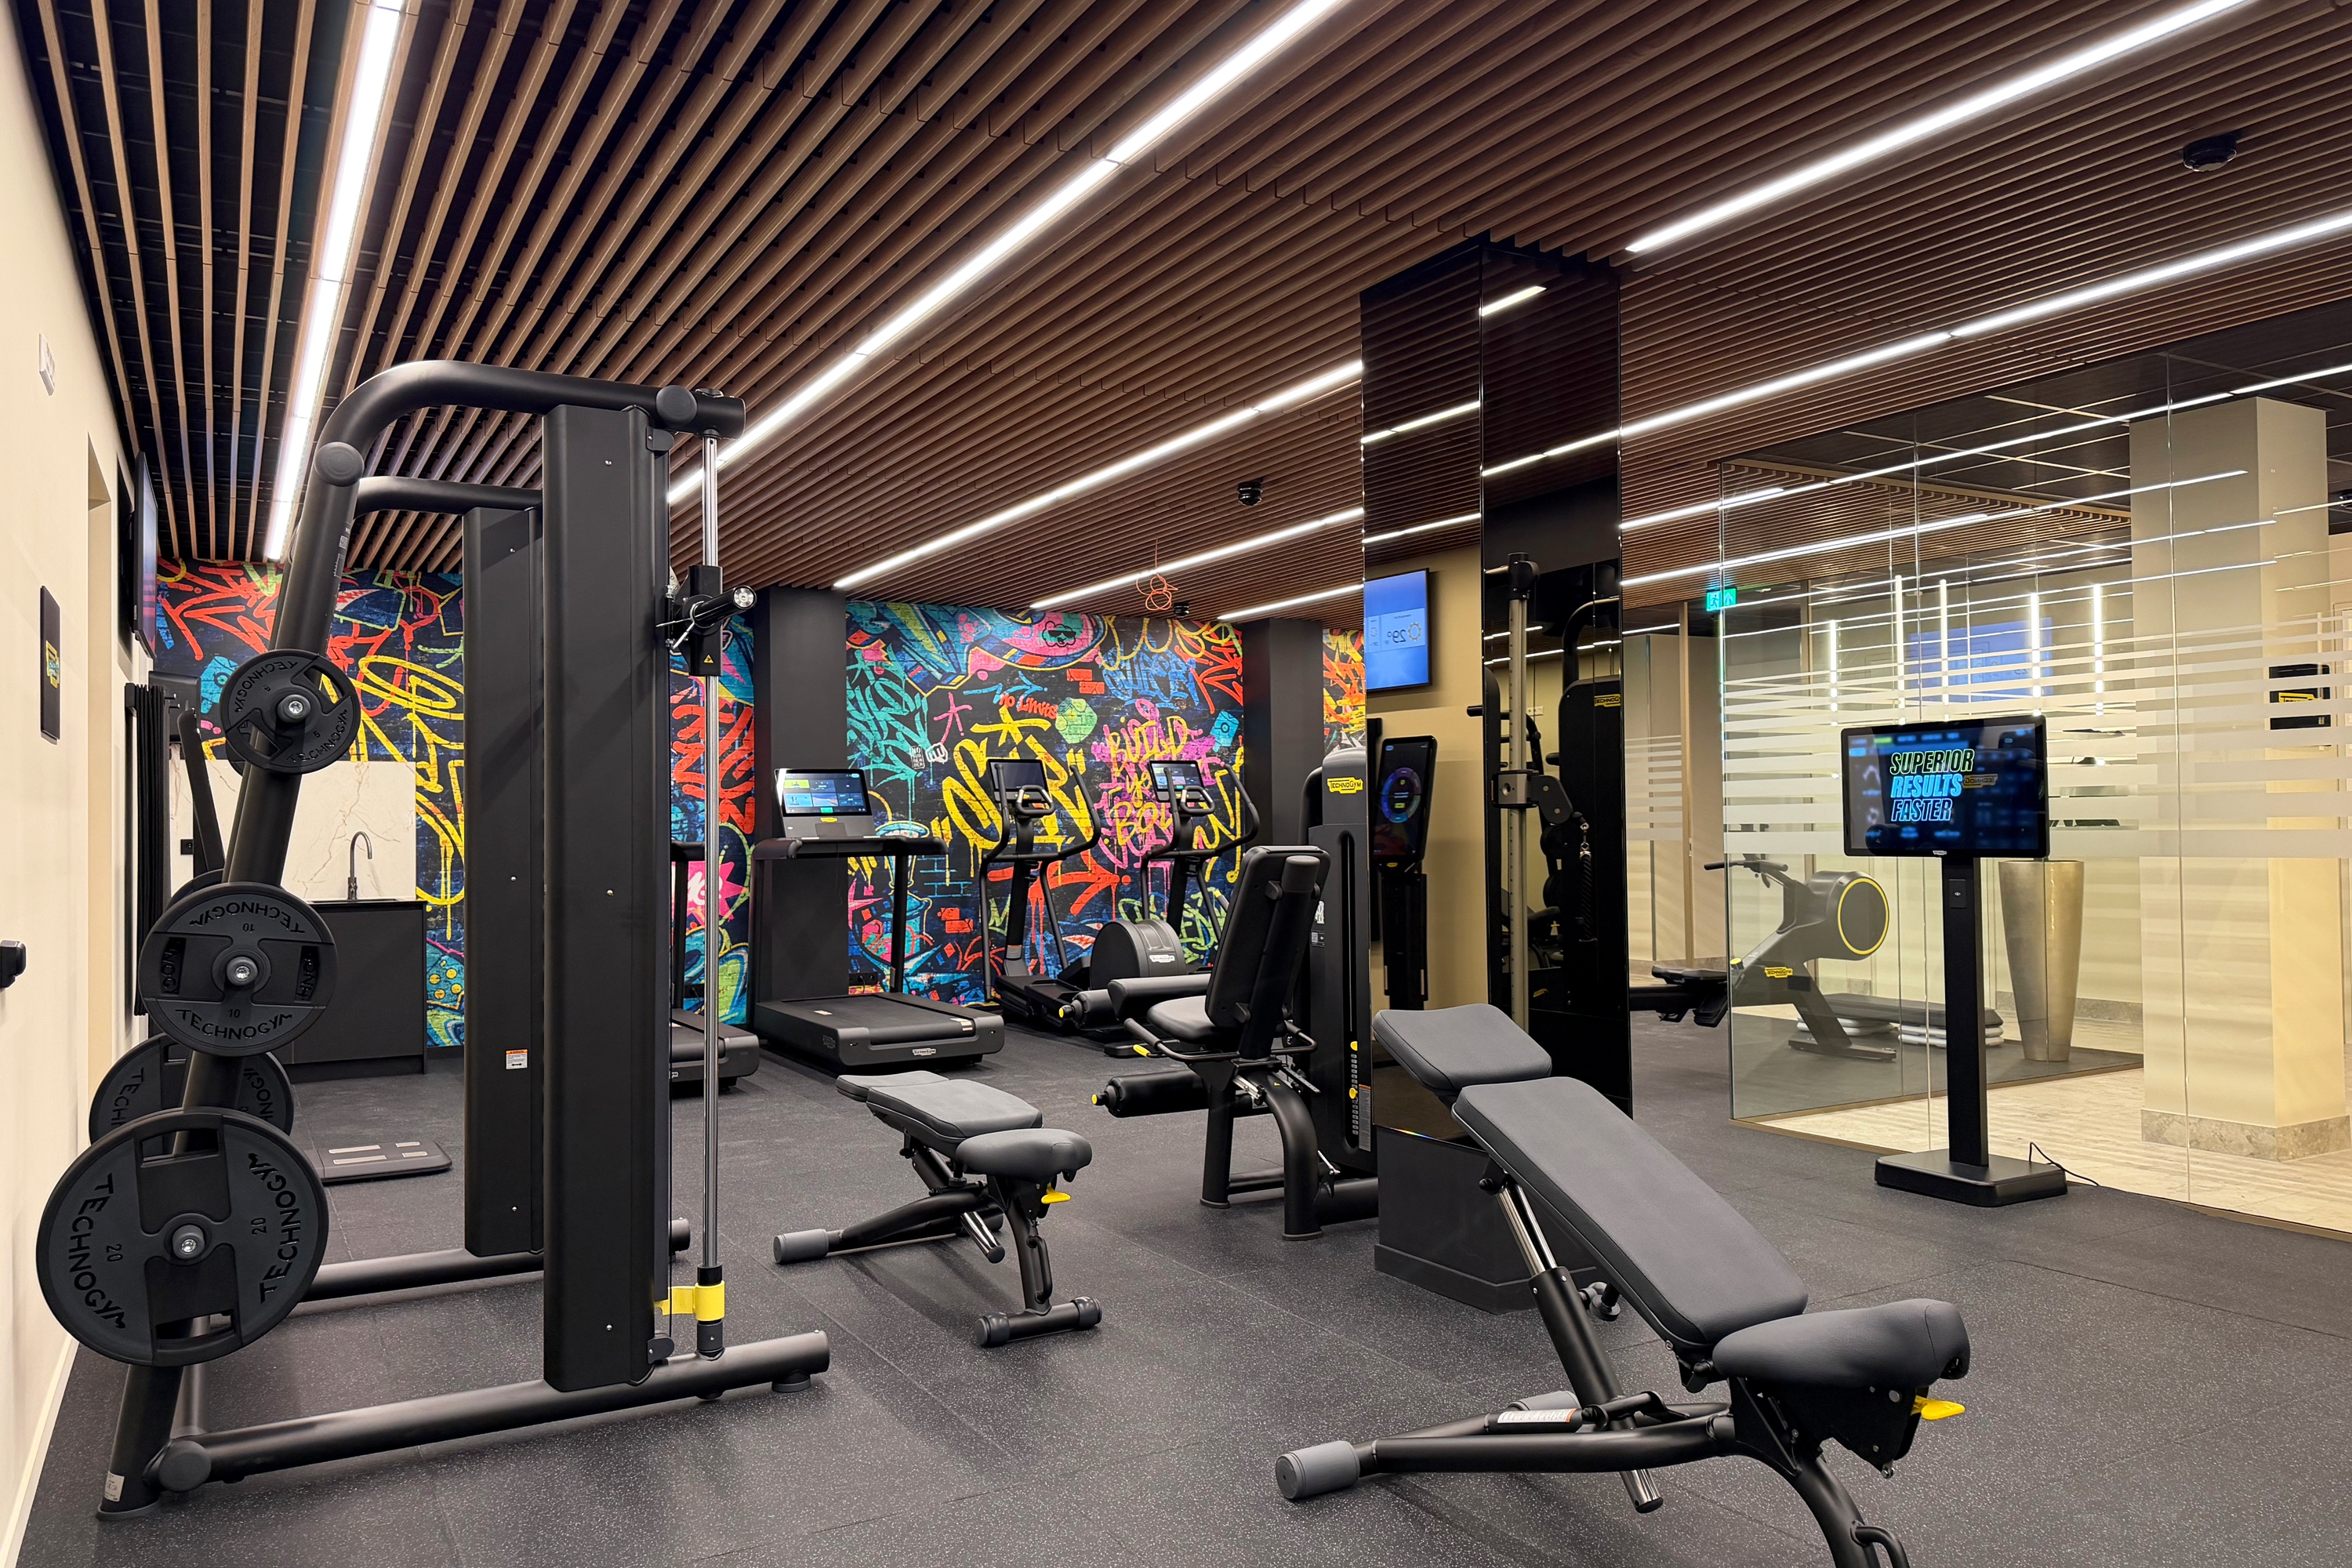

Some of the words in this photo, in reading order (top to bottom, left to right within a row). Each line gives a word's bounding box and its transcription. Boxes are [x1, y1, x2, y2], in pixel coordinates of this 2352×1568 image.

[234, 660, 299, 713] TECHNOGYM
[286, 709, 348, 763] TECHNOGYM
[1889, 749, 1975, 775] SUPERIOR
[1327, 779, 1363, 790] TECHNOGYM
[1891, 773, 1963, 798] RESULTS
[1891, 798, 1953, 822] FASTER
[189, 902, 306, 934] TECHNOGYM
[242, 923, 256, 933] 10
[176, 1009, 292, 1040] TECHNOGYM
[228, 1009, 241, 1018] 10
[248, 1152, 302, 1303] TECHNOGYM
[250, 1217, 267, 1236] 20
[68, 1173, 125, 1329] TECHNOGYM
[106, 1243, 124, 1263] 20
